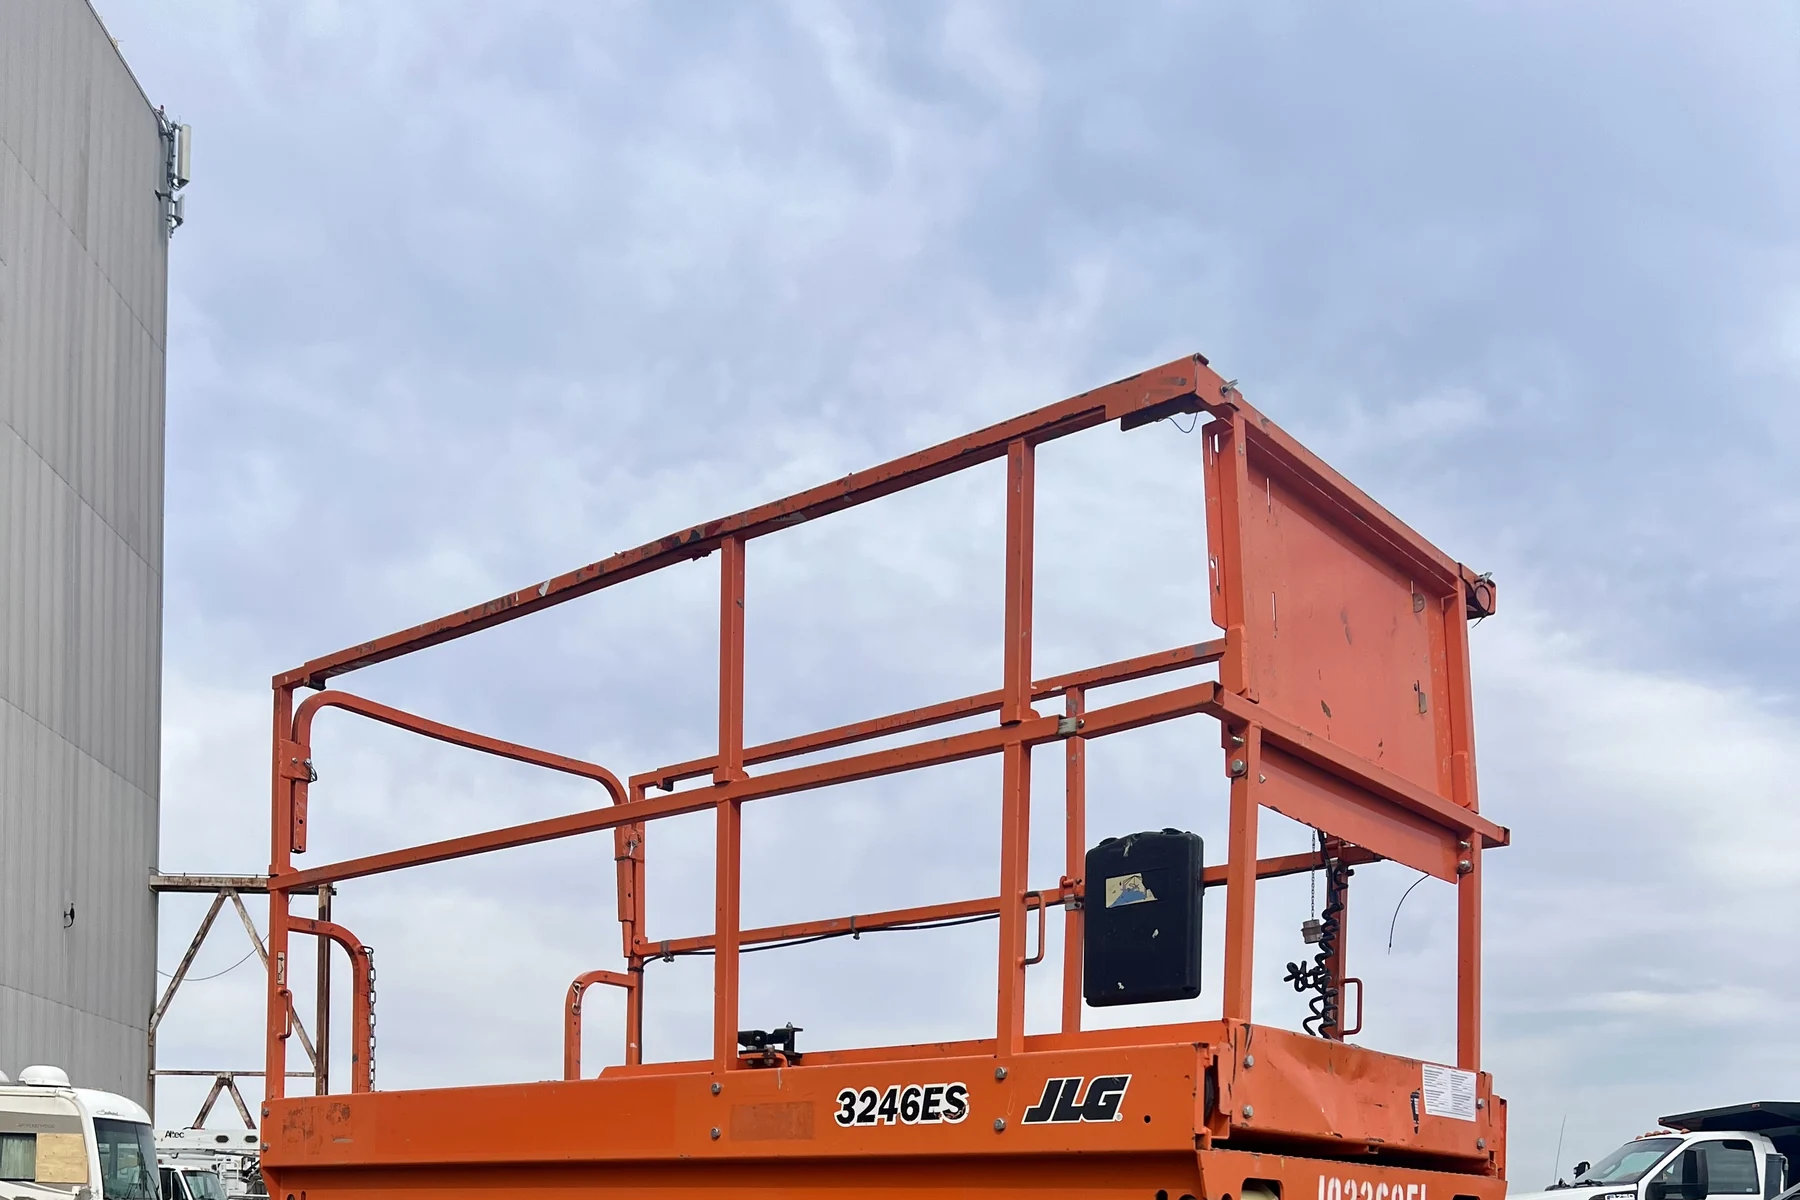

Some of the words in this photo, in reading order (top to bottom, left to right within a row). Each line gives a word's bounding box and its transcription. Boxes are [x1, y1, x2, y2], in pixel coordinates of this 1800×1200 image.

[834, 1083, 969, 1126] 3246ES
[1023, 1075, 1131, 1123] JLG
[165, 1130, 185, 1139] Altec
